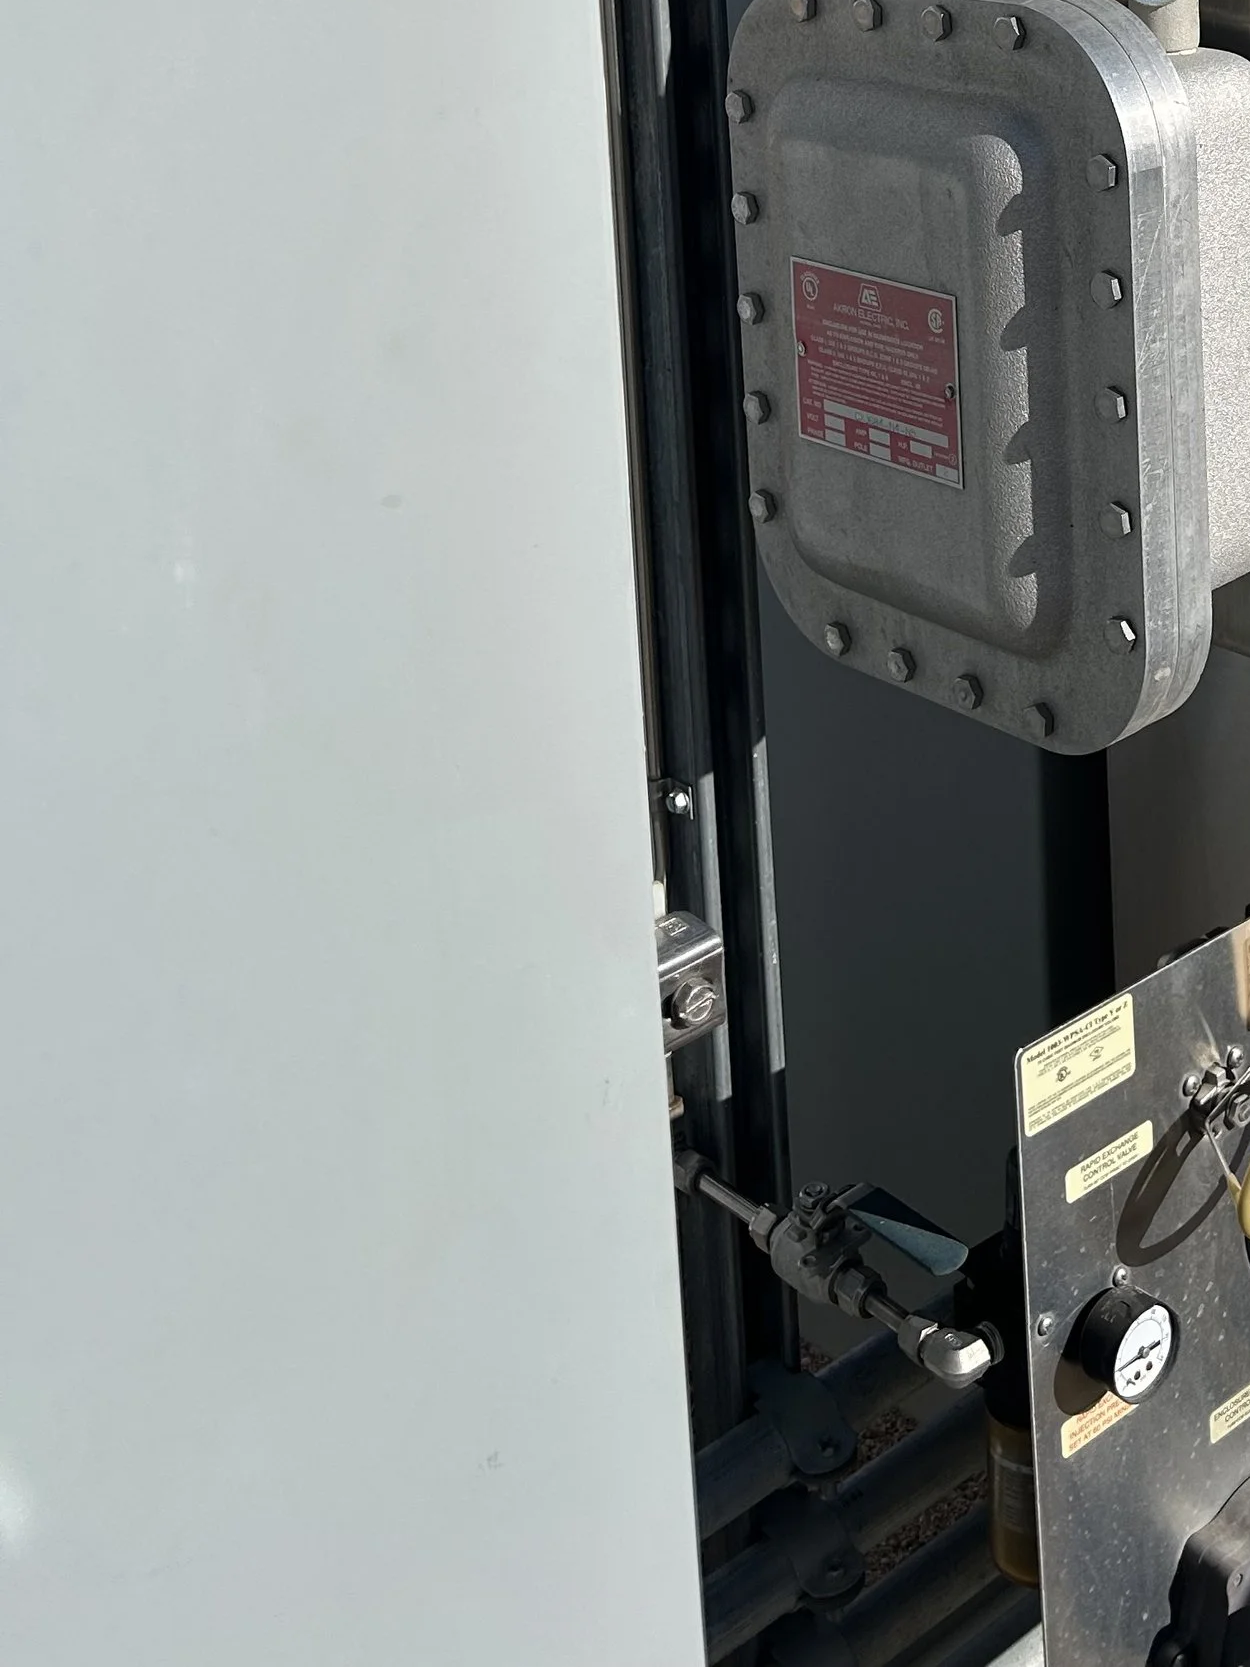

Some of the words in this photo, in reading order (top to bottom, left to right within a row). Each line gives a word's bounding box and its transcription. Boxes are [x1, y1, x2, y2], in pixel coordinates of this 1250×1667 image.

[833, 303, 857, 318] AKRON
[853, 441, 868, 452] POLE
[911, 460, 933, 472] OUTLET
[1026, 1048, 1045, 1064] Model
[1080, 1156, 1101, 1173] RAPID
[1102, 1131, 1139, 1161] EXCHANGE
[1083, 1158, 1116, 1182] CONTROL
[1117, 1143, 1137, 1160] VALVE
[1213, 1388, 1250, 1422] ENCLOSURE
[1069, 1410, 1106, 1440] INJECTION
[1069, 1437, 1082, 1452] SET
[1083, 1430, 1092, 1440] AT
[1102, 1415, 1113, 1426] PSI
